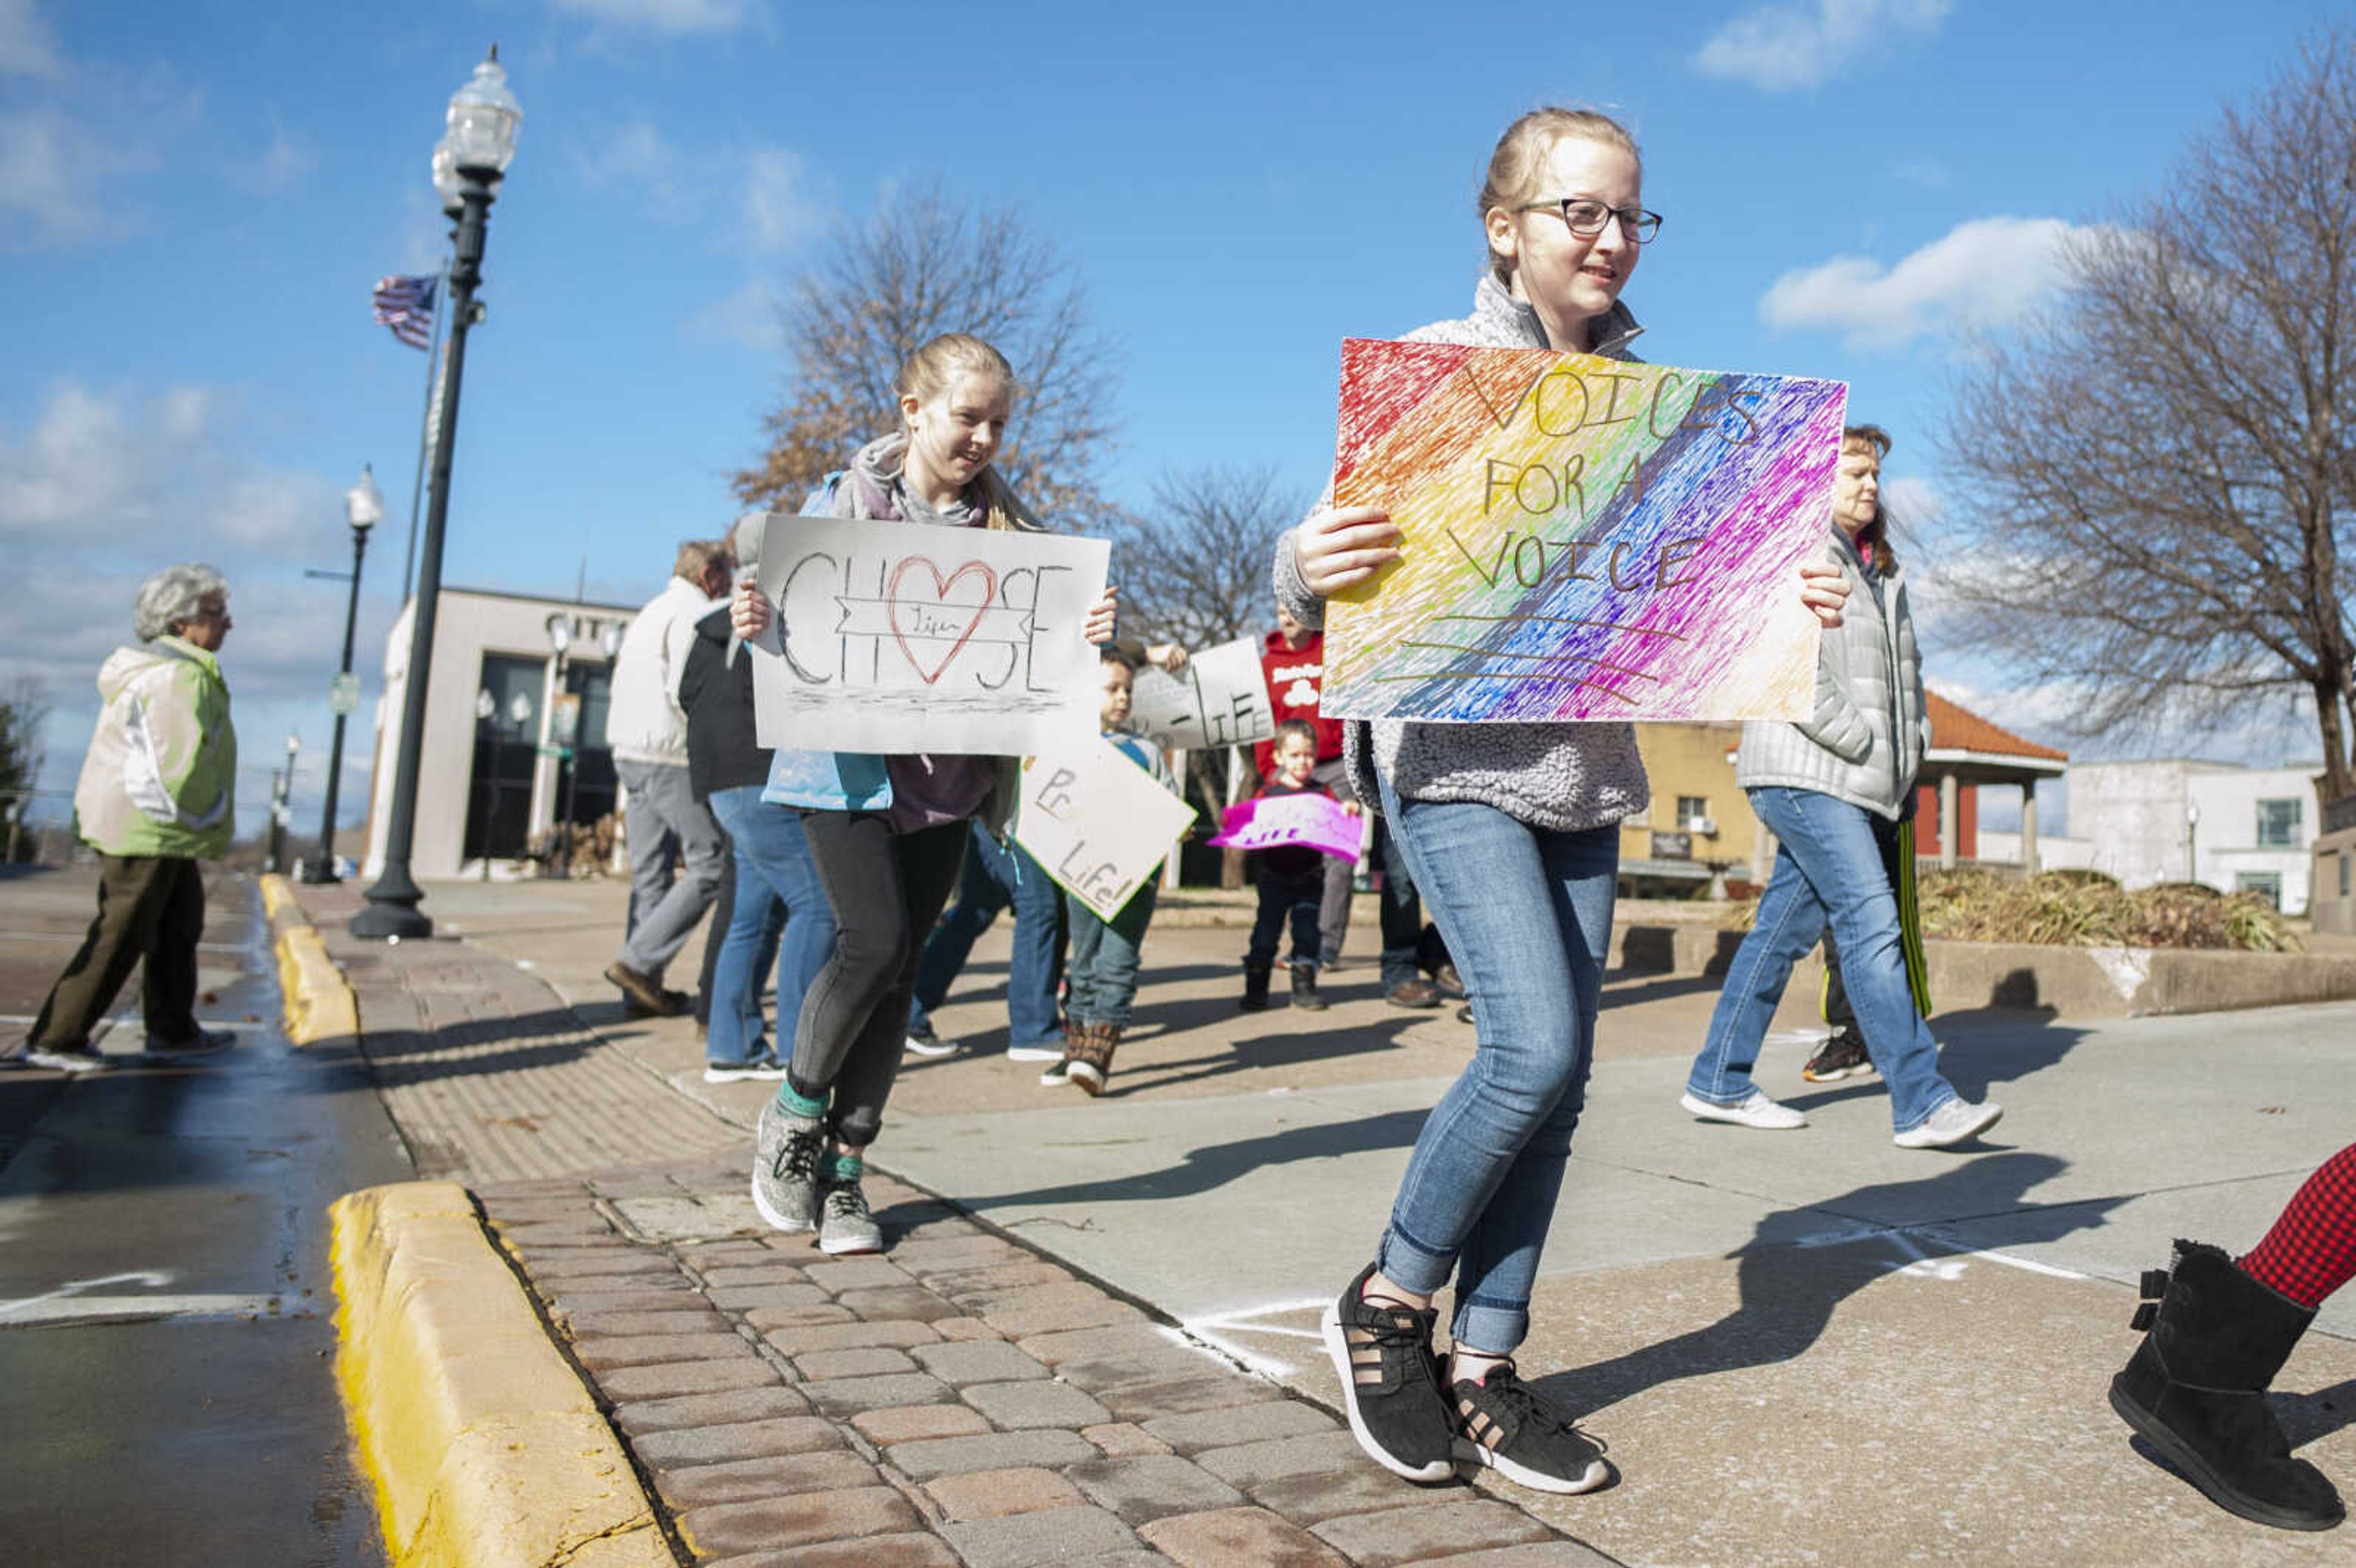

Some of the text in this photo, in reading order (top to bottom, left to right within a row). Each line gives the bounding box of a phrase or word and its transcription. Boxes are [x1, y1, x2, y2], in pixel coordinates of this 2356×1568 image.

[1466, 366, 1760, 447] VOICES
[1484, 451, 1646, 519] FOR A
[1446, 527, 1707, 592] VOICE
